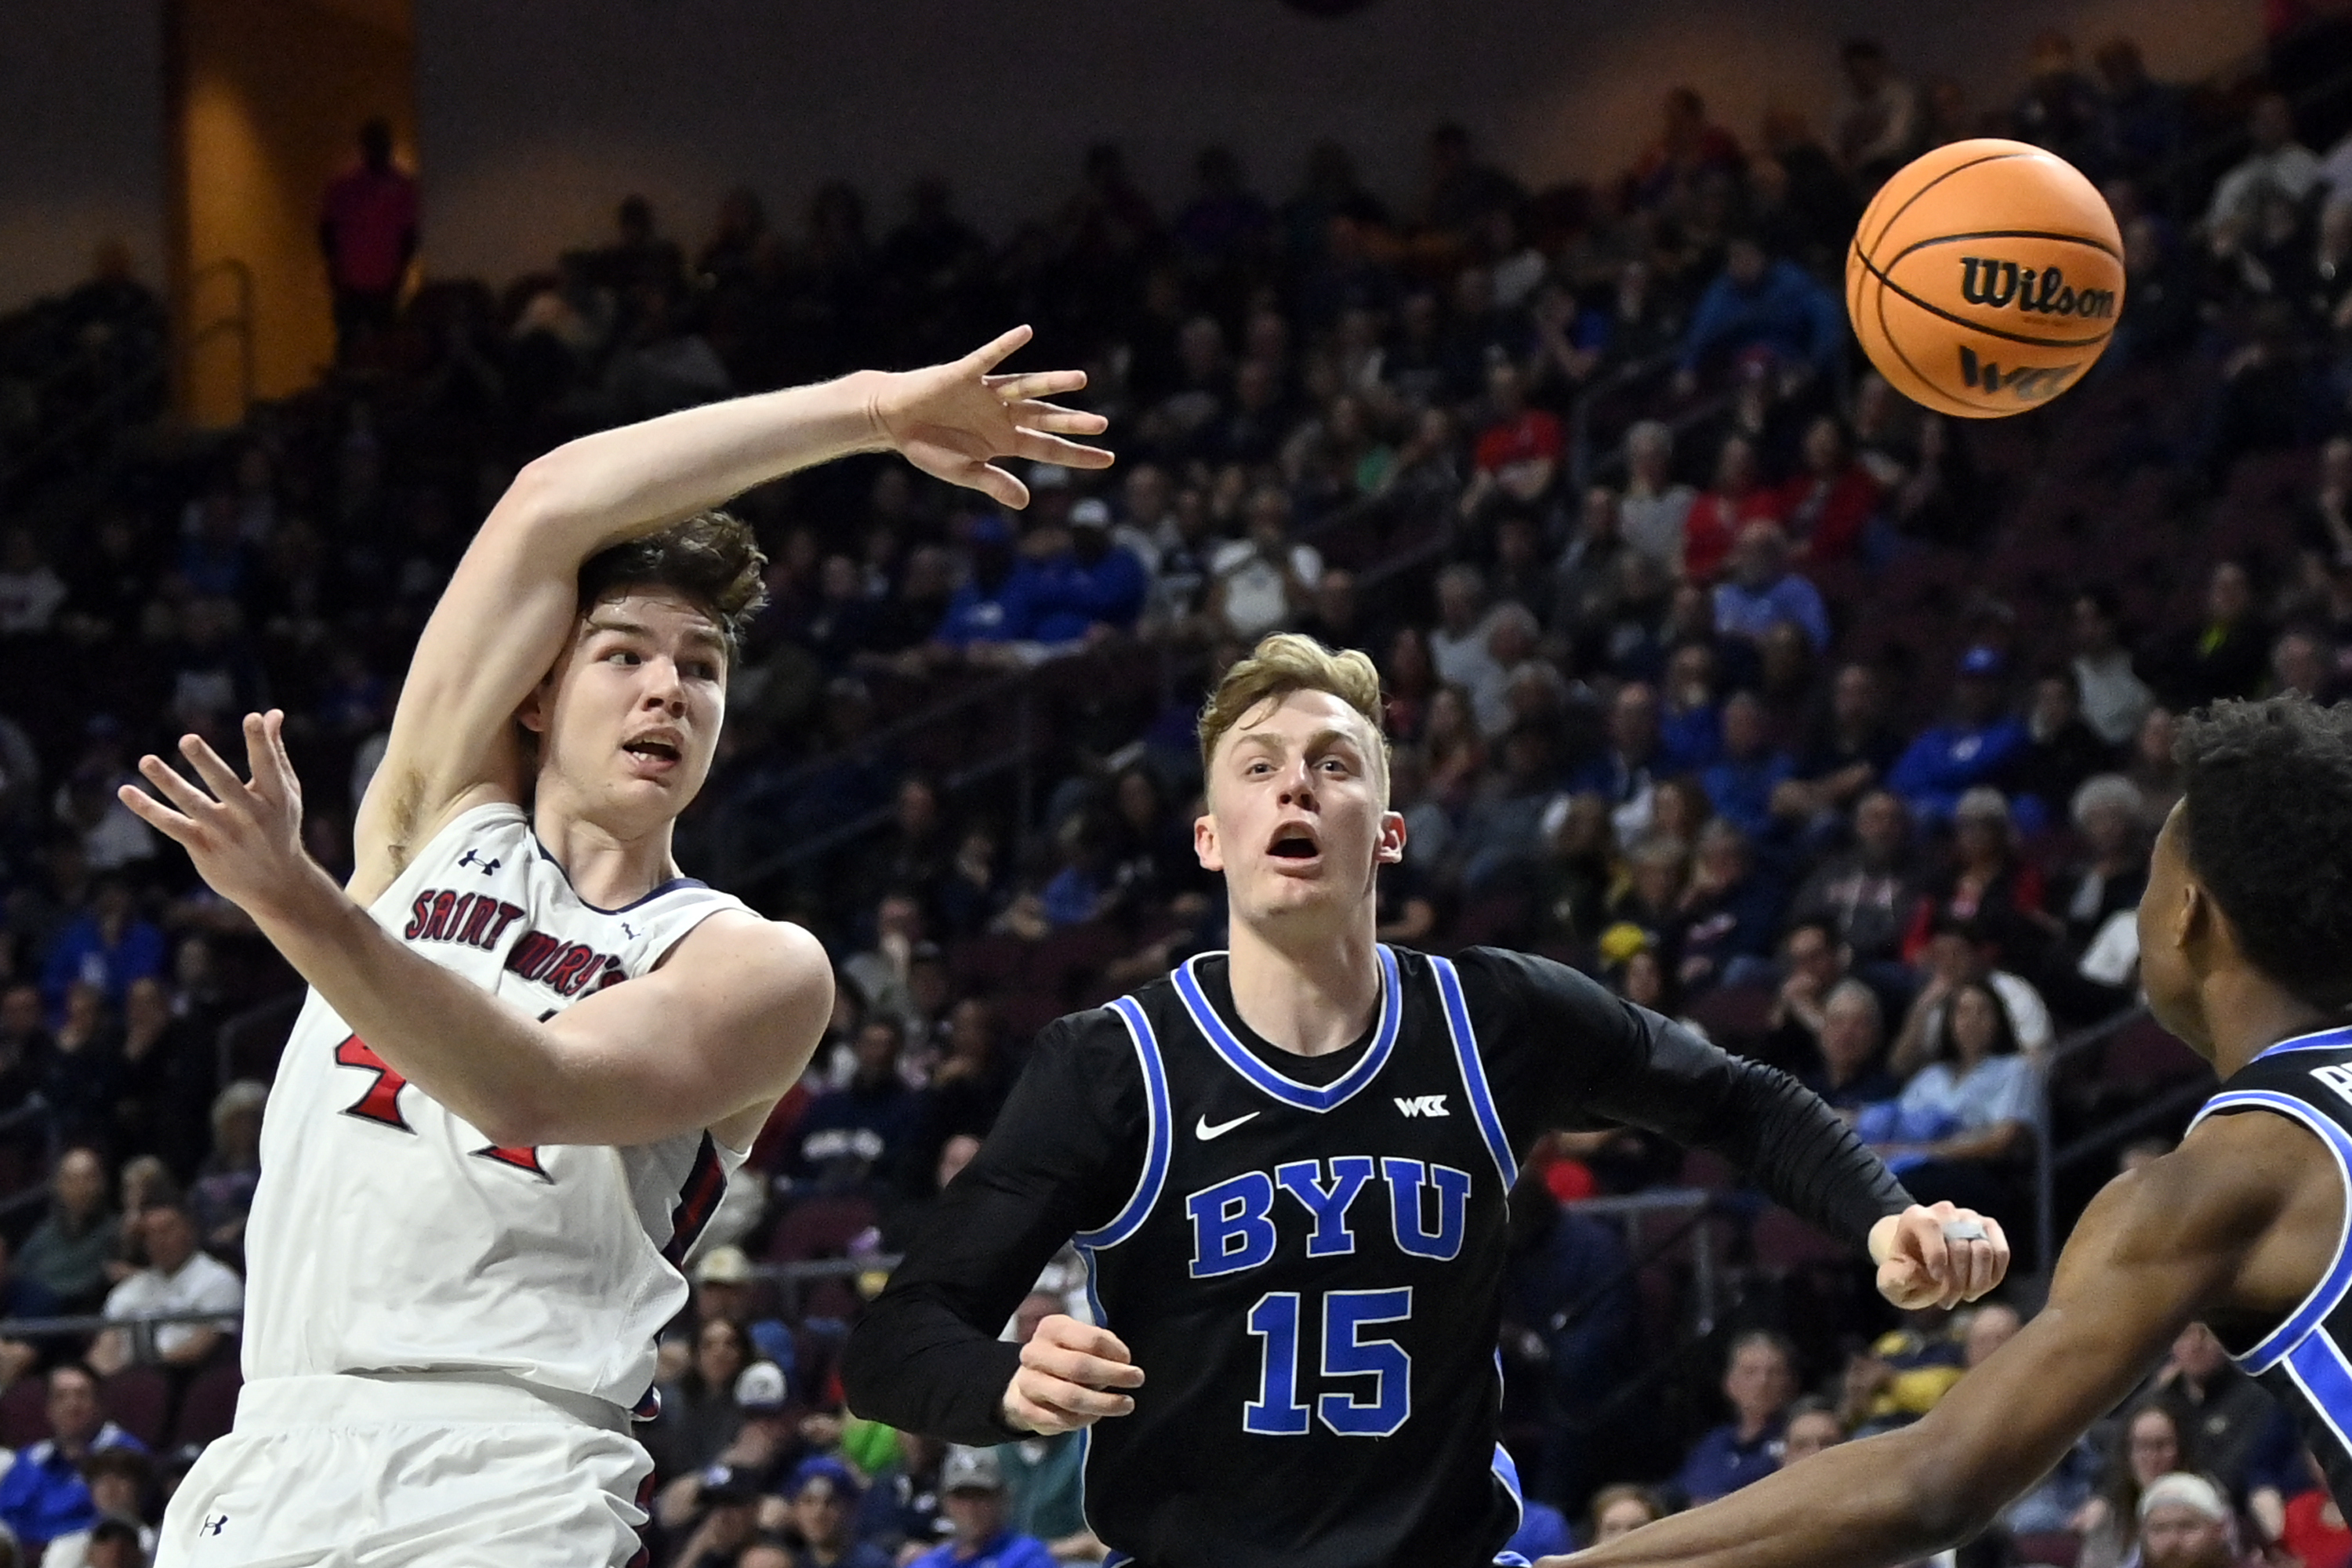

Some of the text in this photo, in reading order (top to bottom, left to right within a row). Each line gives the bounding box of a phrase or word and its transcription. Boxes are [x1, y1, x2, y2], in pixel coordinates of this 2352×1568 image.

[1959, 256, 2114, 318] Wilson
[404, 888, 525, 953] SAINT
[1393, 1094, 1450, 1118] WCC
[1185, 1156, 1472, 1279] BYU
[1243, 1286, 1414, 1437] 15
